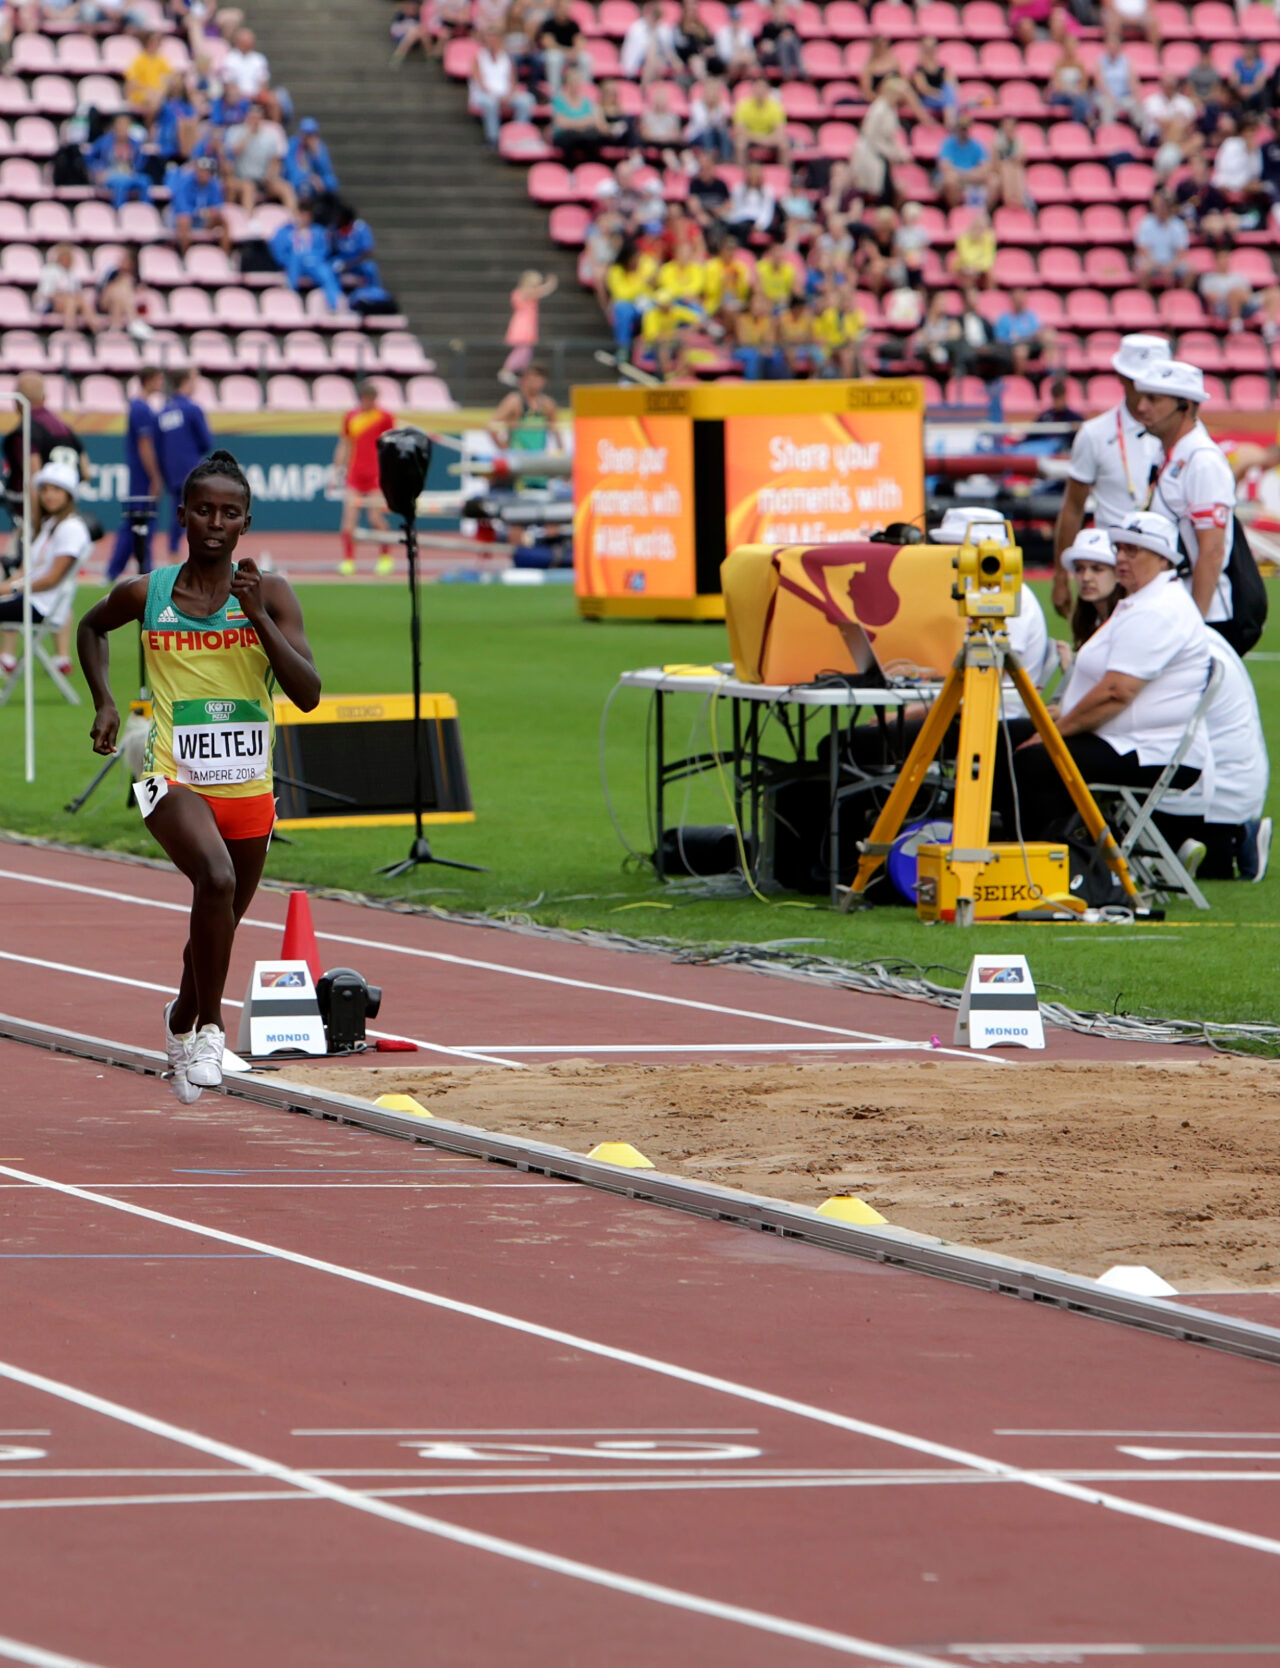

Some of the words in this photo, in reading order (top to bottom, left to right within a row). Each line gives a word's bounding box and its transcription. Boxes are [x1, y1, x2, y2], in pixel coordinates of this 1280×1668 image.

[769, 437, 830, 471] Share
[833, 442, 881, 478] your
[757, 479, 852, 514] moments
[855, 478, 902, 512] with
[148, 627, 260, 651] ETHIOPIA
[208, 703, 233, 713] KOTI
[178, 729, 264, 760] WELTEJI
[188, 769, 233, 782] TAMPERE
[236, 767, 256, 780] 2018
[144, 778, 159, 804] 3
[972, 884, 1044, 902] SEIKO
[266, 1033, 310, 1042] MONDO
[984, 1027, 1029, 1037] MONDO
